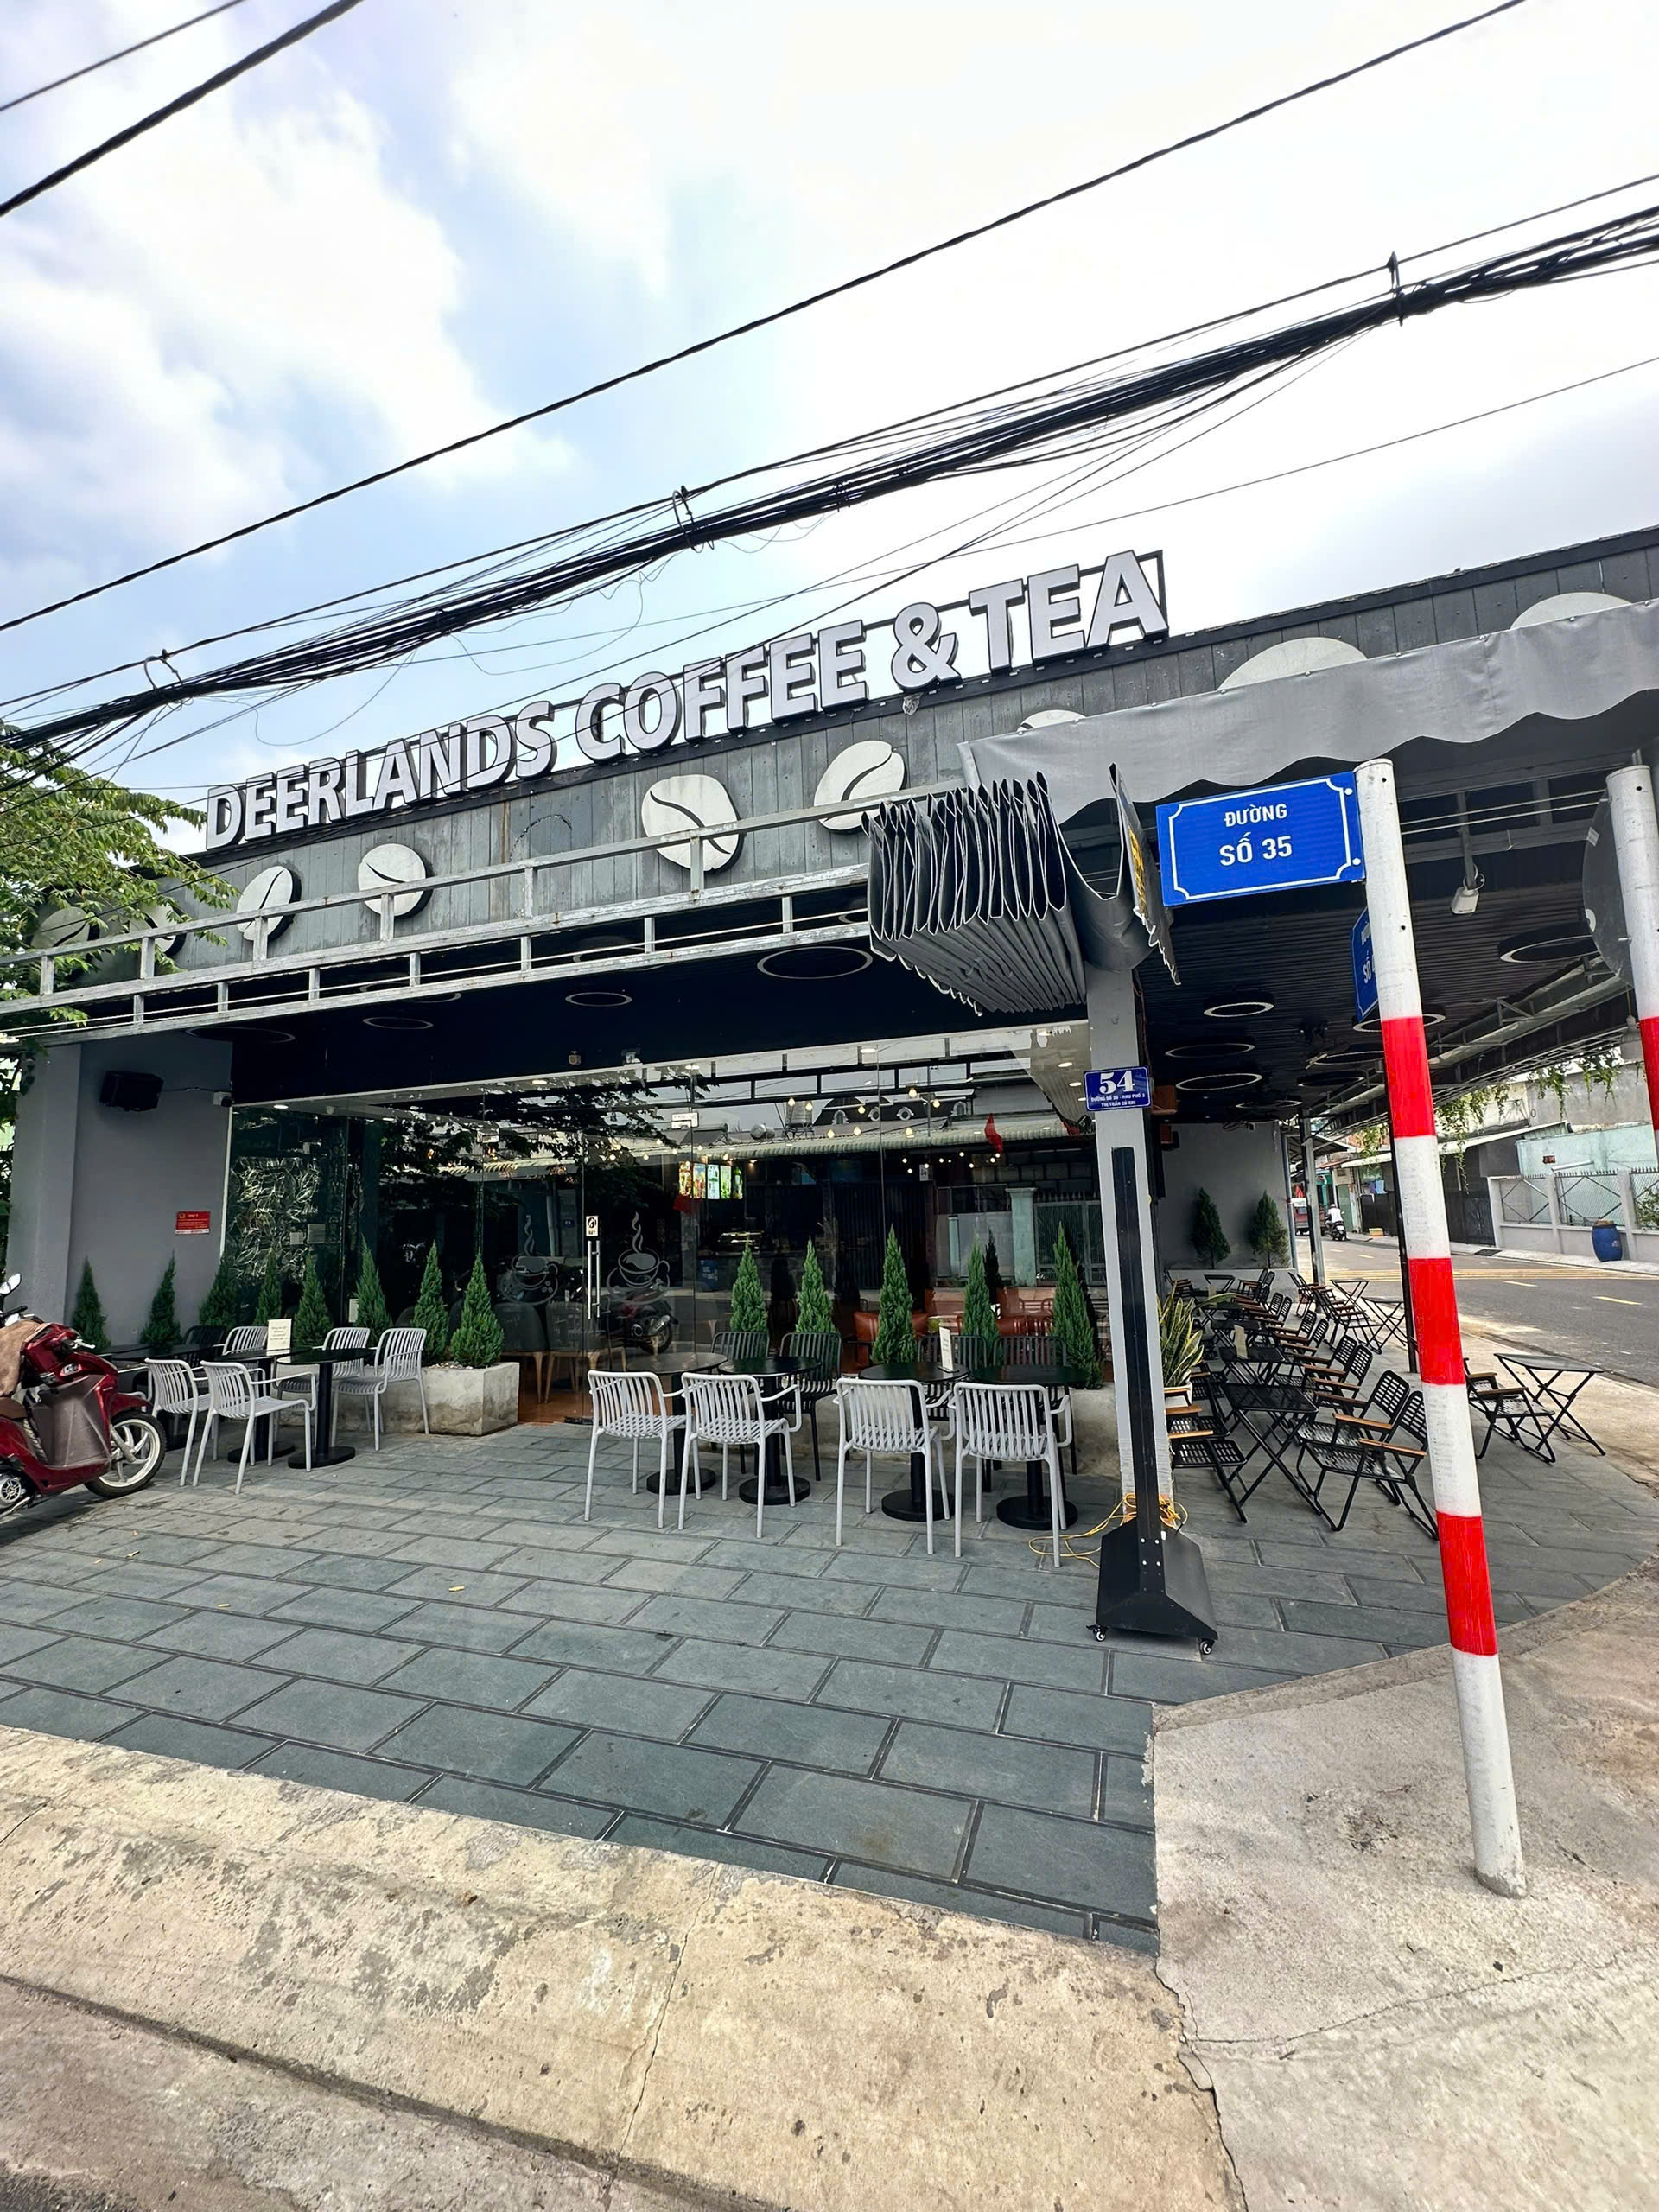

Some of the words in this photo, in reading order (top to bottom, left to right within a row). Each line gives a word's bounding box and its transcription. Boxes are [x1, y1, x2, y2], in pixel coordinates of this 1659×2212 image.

[207, 699, 557, 850] DEERLANDS
[575, 619, 869, 766] COFFEE
[891, 601, 962, 691] &
[968, 550, 1169, 676] TEA
[1224, 803, 1287, 828] ĐƯỜNG
[1219, 831, 1253, 866] SỐ
[1262, 835, 1293, 860] 35
[1099, 1070, 1135, 1095] 54
